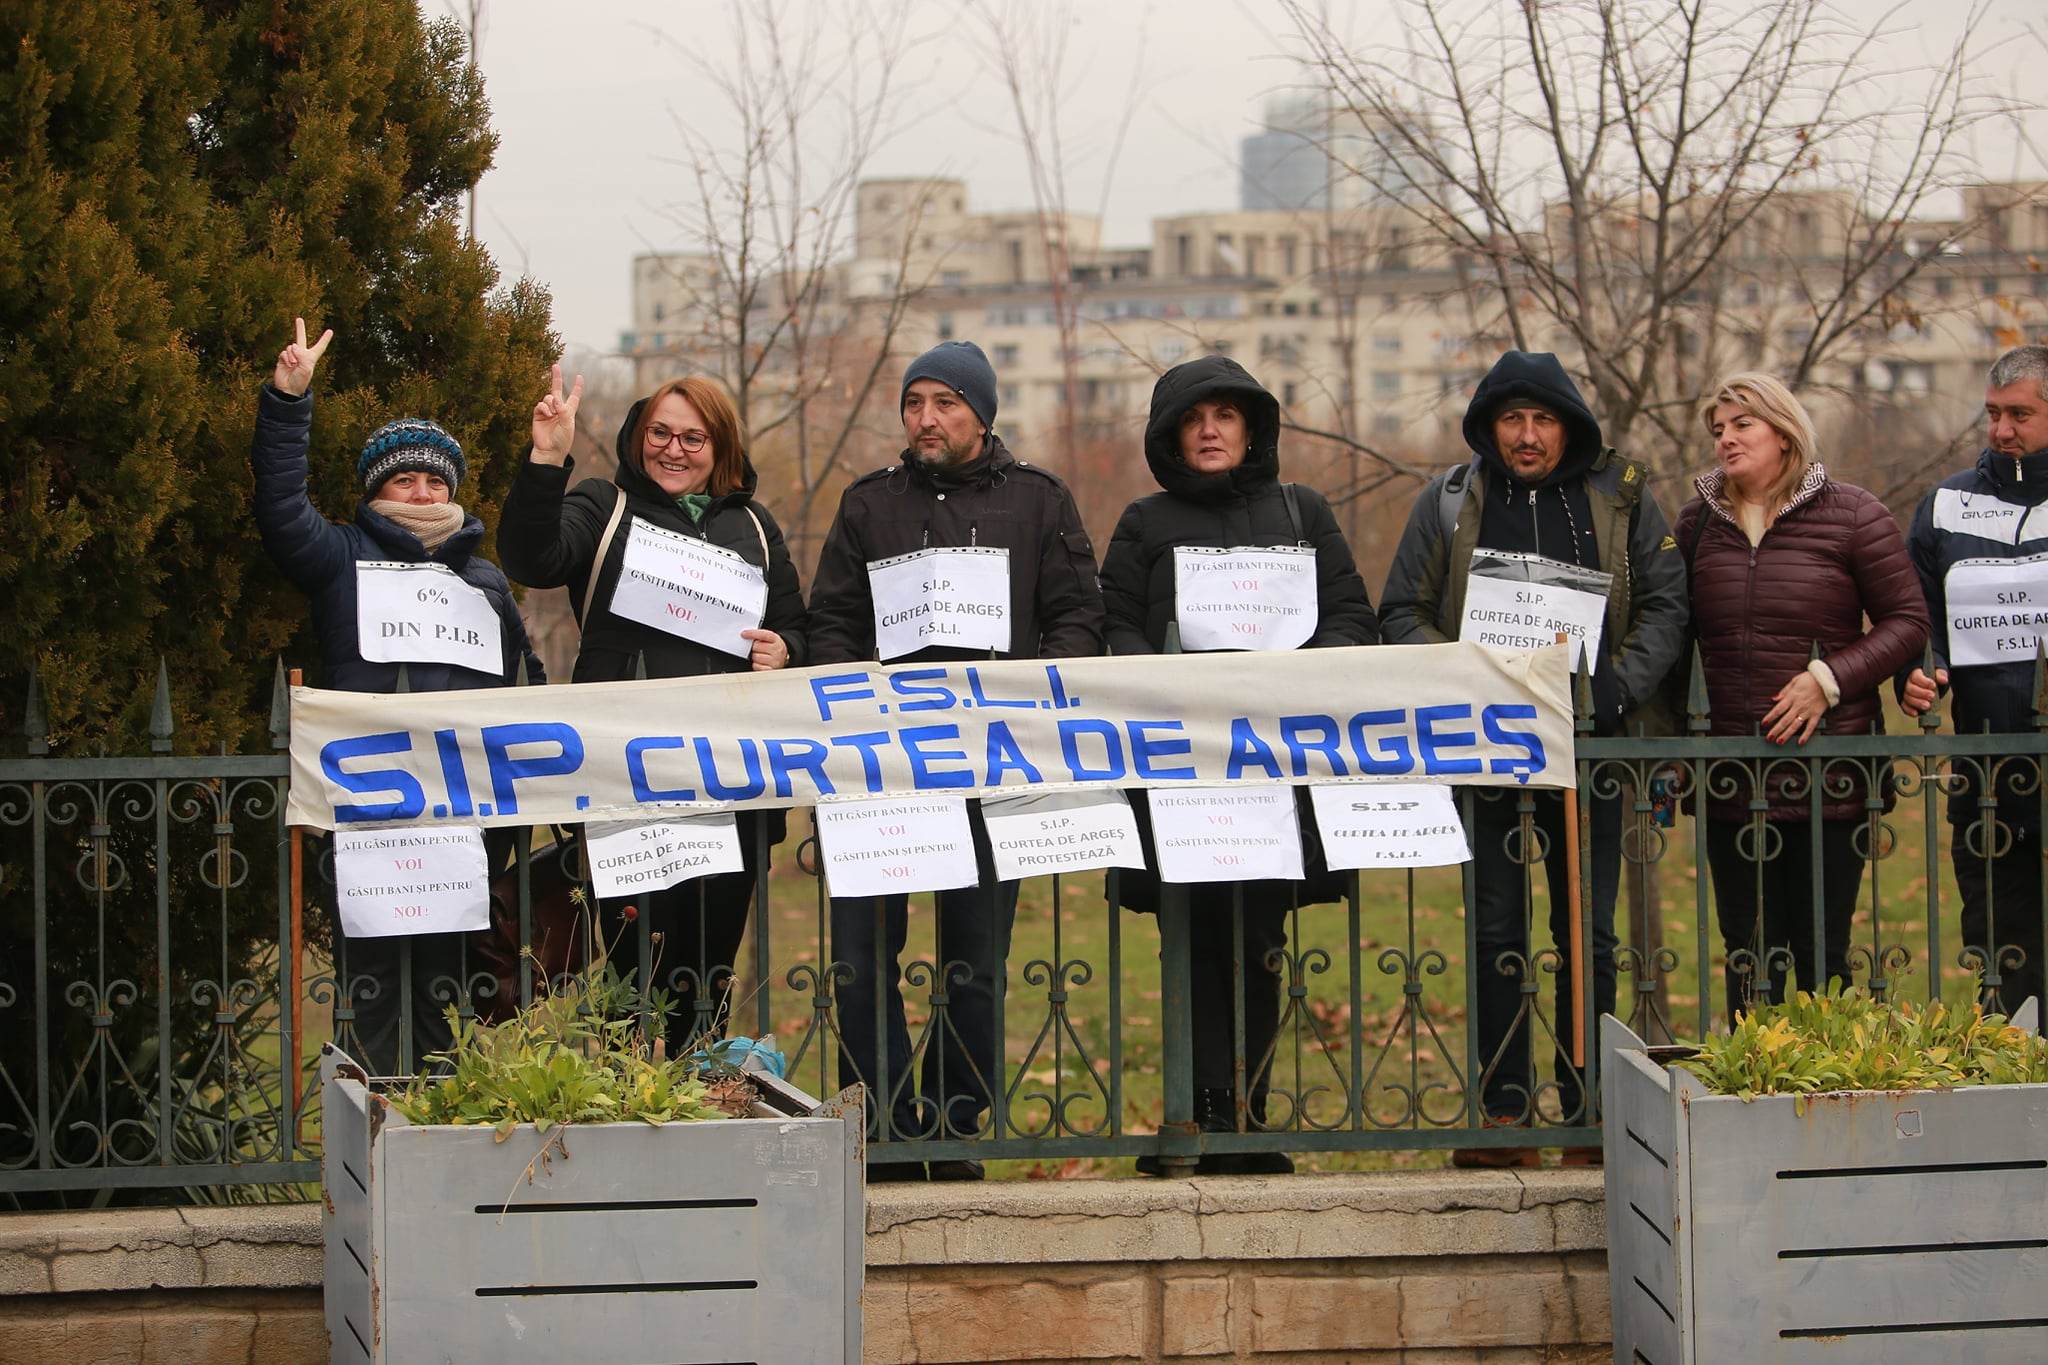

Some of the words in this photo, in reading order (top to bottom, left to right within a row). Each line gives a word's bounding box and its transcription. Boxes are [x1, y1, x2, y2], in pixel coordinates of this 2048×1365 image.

[688, 552, 712, 566] BANI
[680, 565, 705, 582] VOI
[1237, 561, 1261, 570] BANI
[1263, 562, 1303, 573] PENTRU
[922, 579, 955, 593] S.I.P.
[1232, 580, 1259, 592] VOI
[417, 587, 449, 605] 6%
[667, 582, 692, 597] BANI
[705, 595, 745, 615] PENTRU
[1515, 591, 1547, 606] S.I.P.
[1997, 591, 2032, 605] S.I.P.
[882, 603, 930, 627] CURTEA
[934, 600, 952, 613] DE
[1225, 604, 1249, 612] BANI
[1263, 605, 1302, 616] PENTRU
[1470, 609, 1520, 625] CURTEA
[1524, 614, 1541, 627] DE
[1954, 614, 2008, 630] CURTEA
[2012, 614, 2030, 626] DE
[381, 622, 421, 638] DIN
[435, 624, 485, 647] P.I.B.
[919, 621, 961, 637] F.S.L.I.
[812, 665, 1080, 721] F.S.L.I.
[321, 724, 588, 821] S.I.P.
[626, 722, 1040, 801] CURTEA
[1059, 720, 1195, 781] DE
[881, 807, 908, 816] BANI
[1040, 818, 1074, 830] S.I.P.
[1208, 815, 1234, 825] VOI
[640, 827, 674, 841] S.I.P.
[878, 825, 906, 837] VOI
[400, 837, 426, 847] BANI
[429, 835, 472, 845] PENTRU
[1000, 838, 1055, 850] CURTEA
[1058, 835, 1077, 845] DE
[597, 850, 653, 869] CURTEA
[656, 843, 673, 857] DE
[873, 849, 900, 858] BANI
[1018, 846, 1116, 866] PROTESTEAZĂ
[394, 858, 422, 871] VOI
[615, 854, 710, 885] PROTESTEAZĂ
[387, 885, 413, 895] BANI
[429, 881, 473, 892] PENTRU
